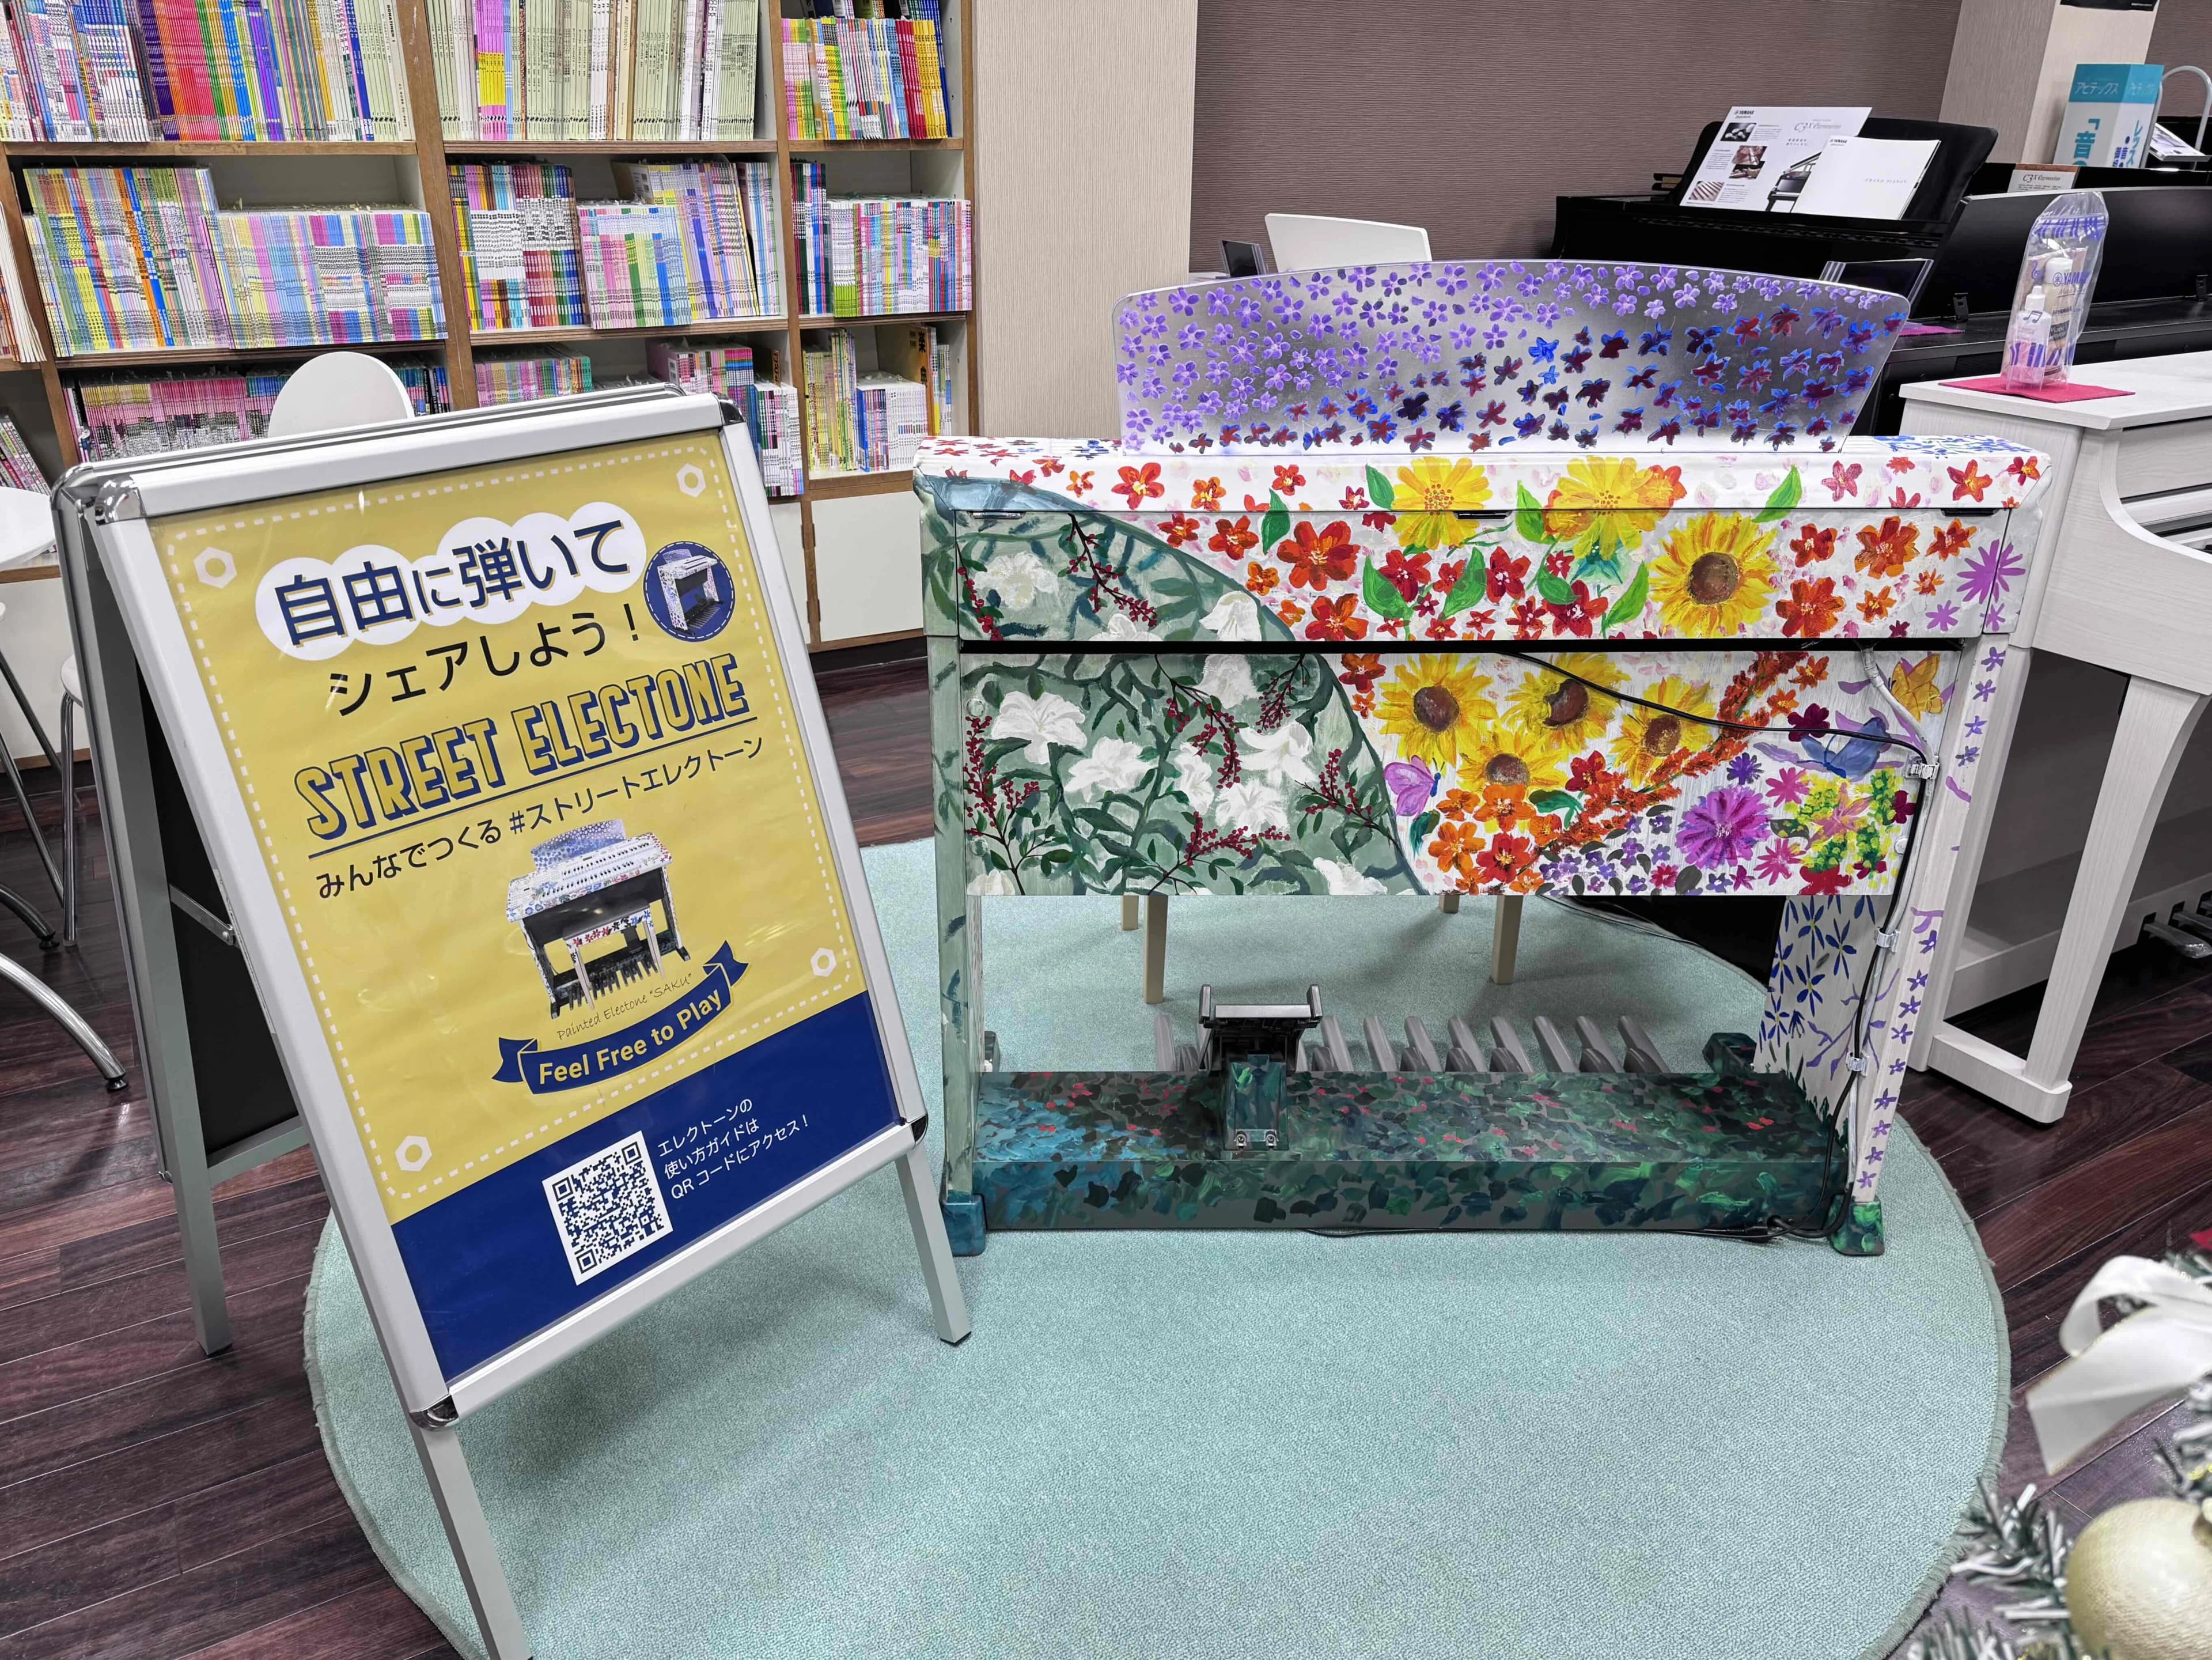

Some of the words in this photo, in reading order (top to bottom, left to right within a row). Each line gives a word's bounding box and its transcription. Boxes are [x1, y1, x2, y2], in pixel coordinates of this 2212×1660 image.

[274, 520, 630, 646] 自由に弾いて
[328, 603, 639, 717] シェアしよう！
[294, 717, 507, 840] STREET
[510, 653, 751, 776] ELECTONE
[316, 818, 502, 899] みんなでつくる
[509, 737, 764, 835] #ストリートエレクトーン
[539, 1053, 590, 1085] Feel
[596, 1039, 647, 1071] Free
[651, 1024, 675, 1046] to
[676, 989, 722, 1030] Play
[557, 1009, 601, 1041] Painted
[604, 994, 647, 1020] Electone
[657, 1098, 753, 1157] エレクトーンの
[664, 1118, 760, 1180] 使い方ガイドは
